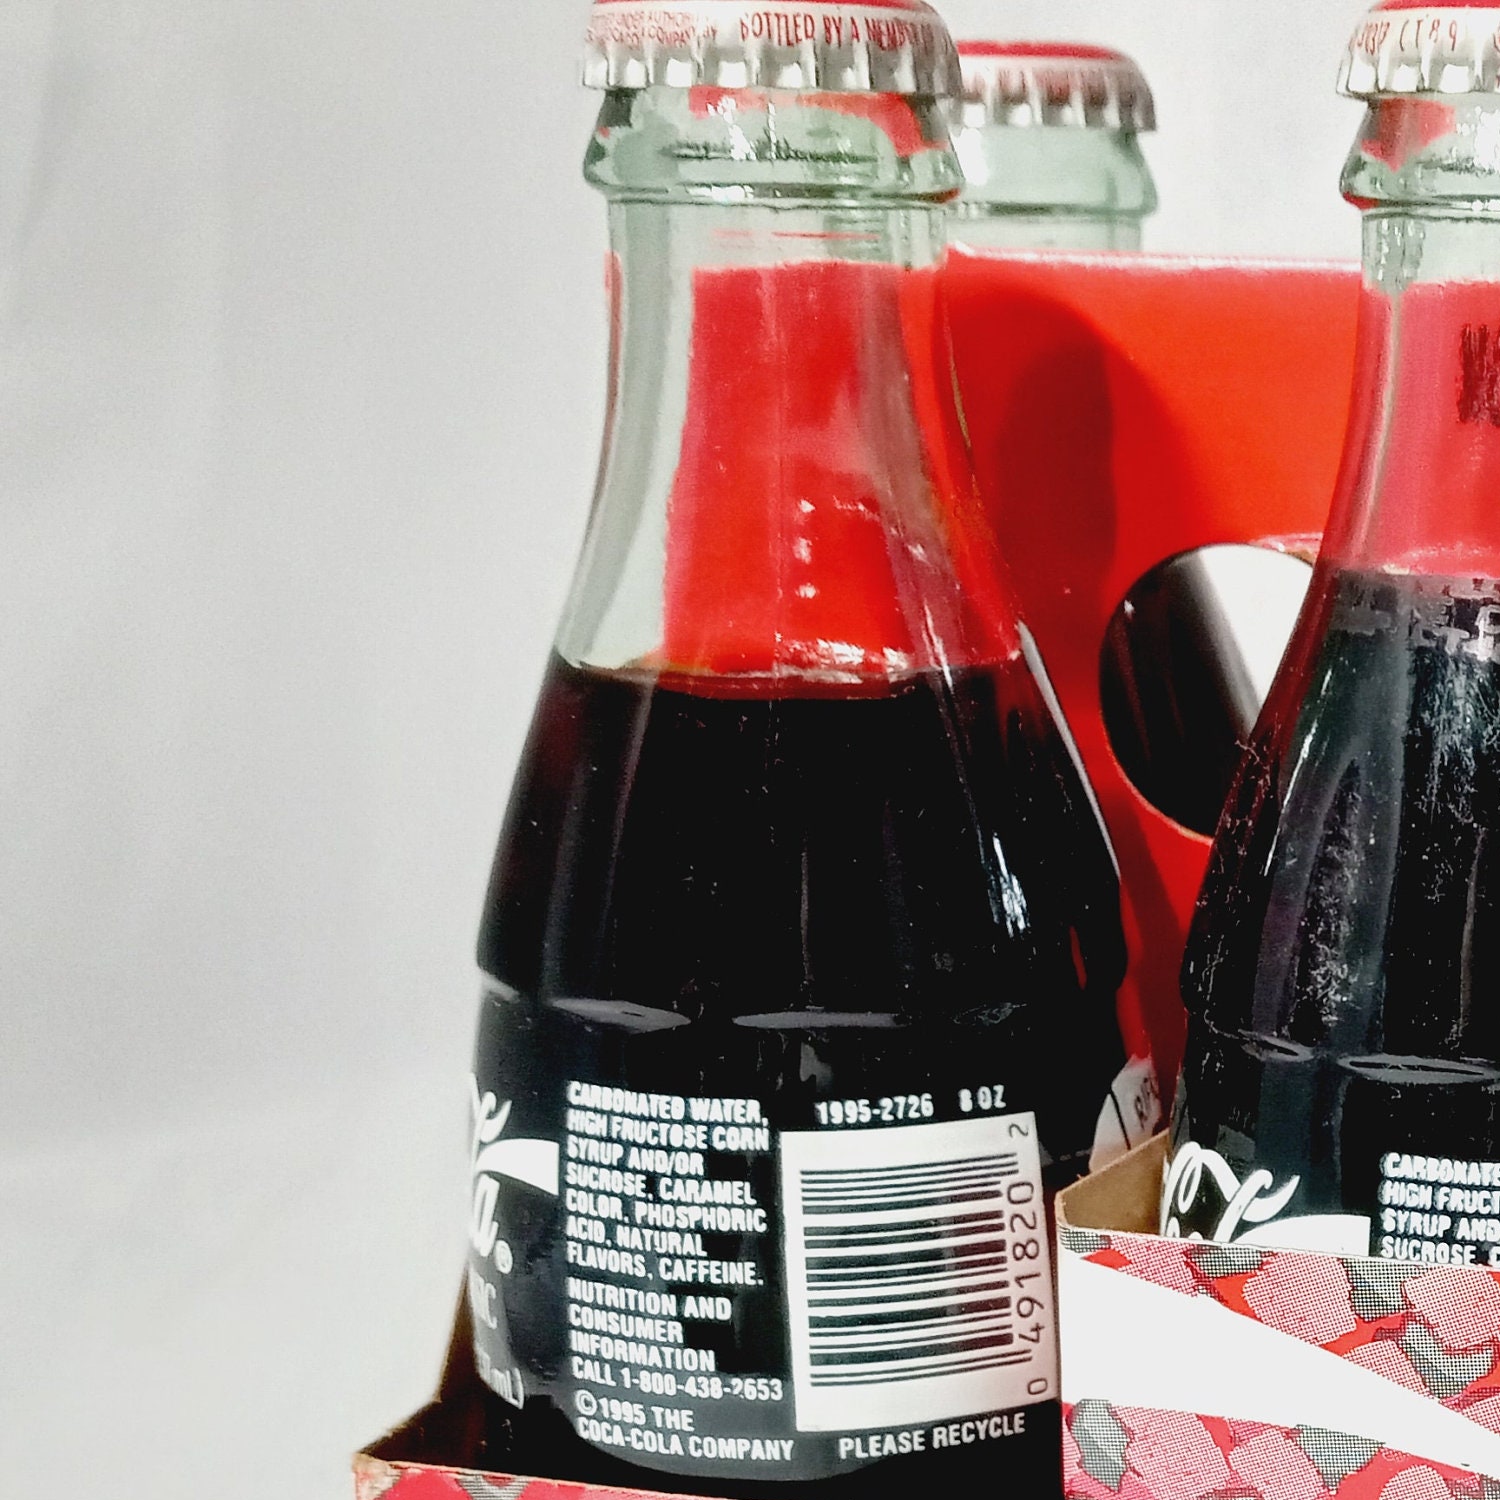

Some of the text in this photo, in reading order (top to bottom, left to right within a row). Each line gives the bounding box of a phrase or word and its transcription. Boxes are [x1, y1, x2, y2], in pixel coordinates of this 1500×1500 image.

[822, 15, 842, 48] BY
[850, 16, 860, 42] A
[567, 1080, 685, 1120] CARBONATED
[815, 1085, 1006, 1126] 1995-2726 8 OZ
[568, 1109, 769, 1151] HIGH FRUCTOSE CORN
[567, 1134, 704, 1176] SYRUP AND/OR
[659, 1179, 756, 1205] CARAMEL
[1380, 1181, 1433, 1210] HIGH
[635, 1202, 767, 1233] PHOSPHORIC
[1381, 1208, 1451, 1237] SYRUP
[617, 1227, 707, 1257] NATURAL
[659, 1258, 764, 1285] CAFFEINE.
[1007, 1181, 1045, 1345] 491820
[567, 1277, 733, 1320] NUTRITION AND
[568, 1304, 683, 1343] CONSUMER
[570, 1330, 716, 1372] INFORMATION
[571, 1356, 616, 1386] CALL
[577, 1417, 794, 1460] COCA-COLA COMPANY
[650, 1406, 694, 1432] THE
[839, 1413, 1026, 1460] PLEASE RECYCLE
